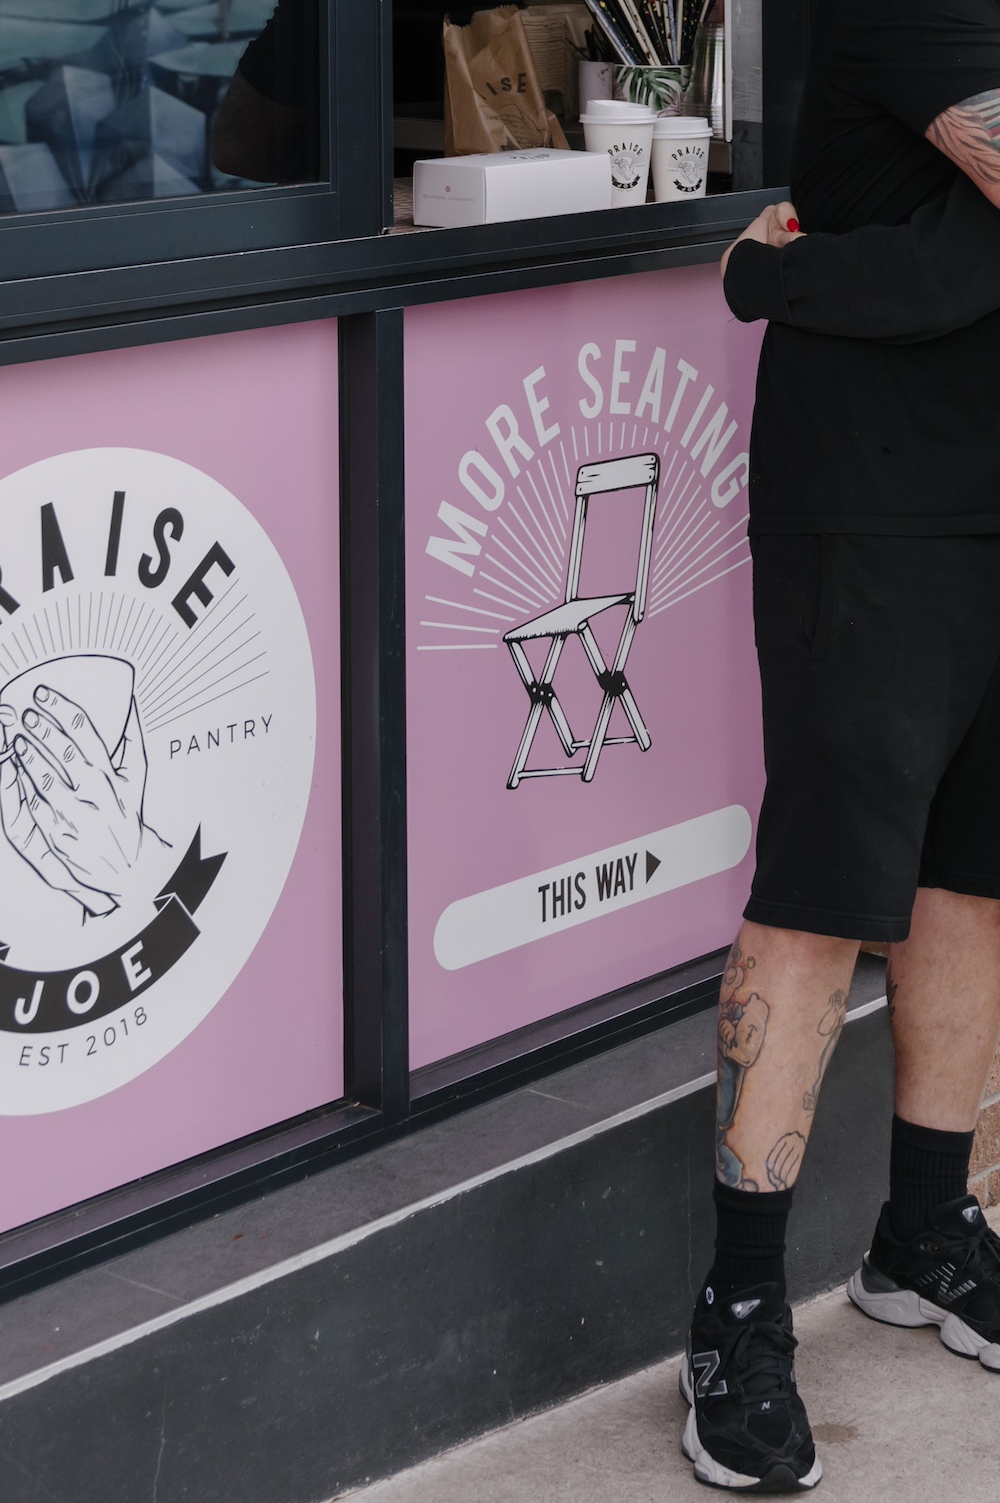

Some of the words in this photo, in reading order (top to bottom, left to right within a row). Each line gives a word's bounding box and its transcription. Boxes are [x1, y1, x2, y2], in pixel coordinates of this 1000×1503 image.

[607, 142, 643, 156] PRAISE
[671, 146, 705, 161] PRAISE
[425, 365, 561, 577] MORE
[577, 338, 750, 509] SEATING
[169, 713, 274, 760] PANTRY
[538, 871, 587, 923] THIS
[595, 852, 639, 897] WAY
[14, 939, 153, 1025] JOE
[19, 1043, 69, 1067] EST
[86, 1006, 148, 1056] 2018
